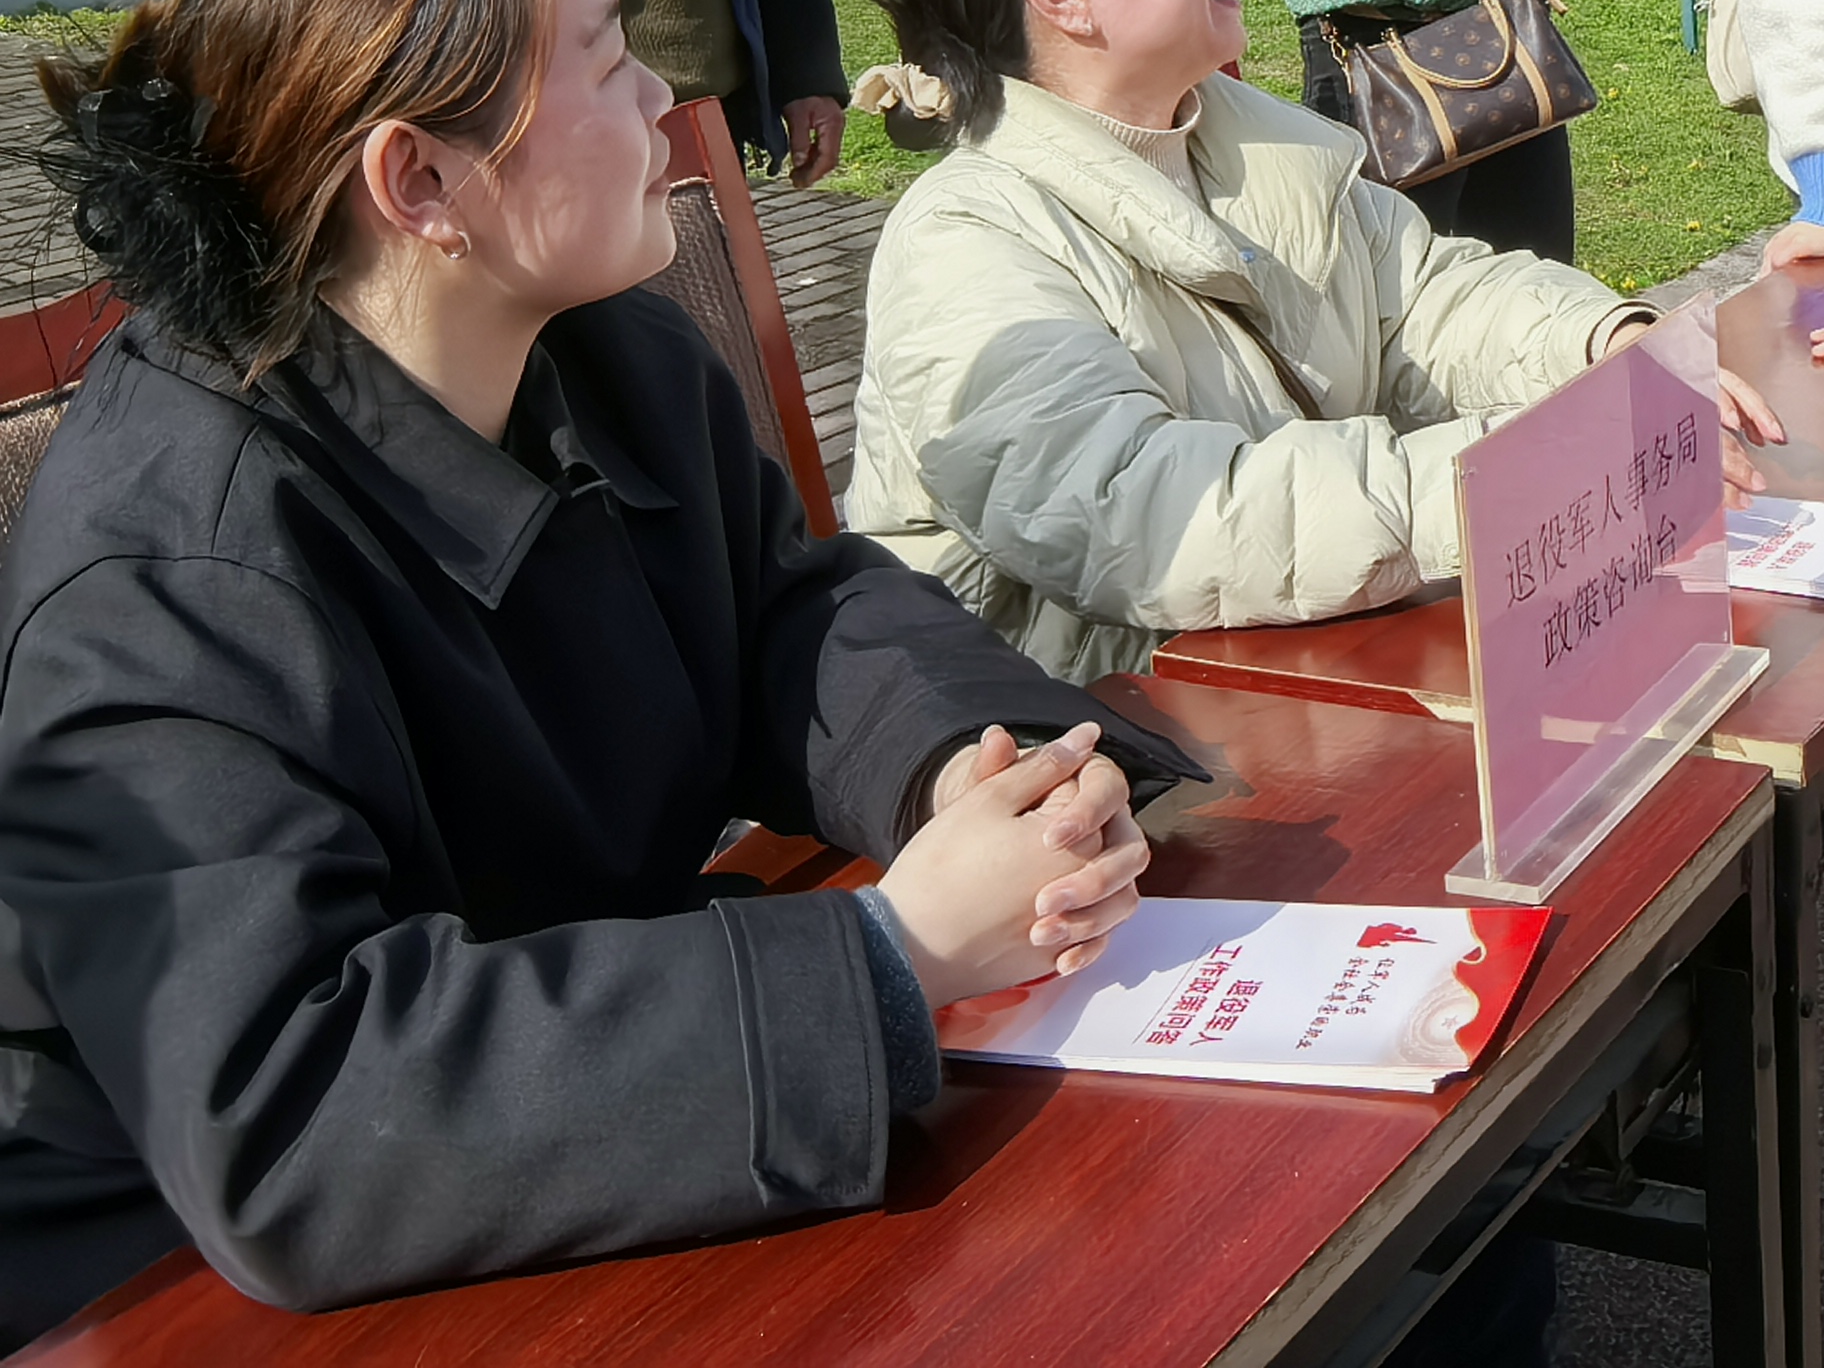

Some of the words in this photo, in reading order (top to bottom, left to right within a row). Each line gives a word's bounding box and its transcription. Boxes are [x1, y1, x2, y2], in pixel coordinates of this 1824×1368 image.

[1505, 413, 1698, 608] 退役军人事务局
[1543, 514, 1677, 669] 政策咨询台
[1146, 943, 1242, 1045] 工作政策问答
[1189, 980, 1263, 1046] 退役军人
